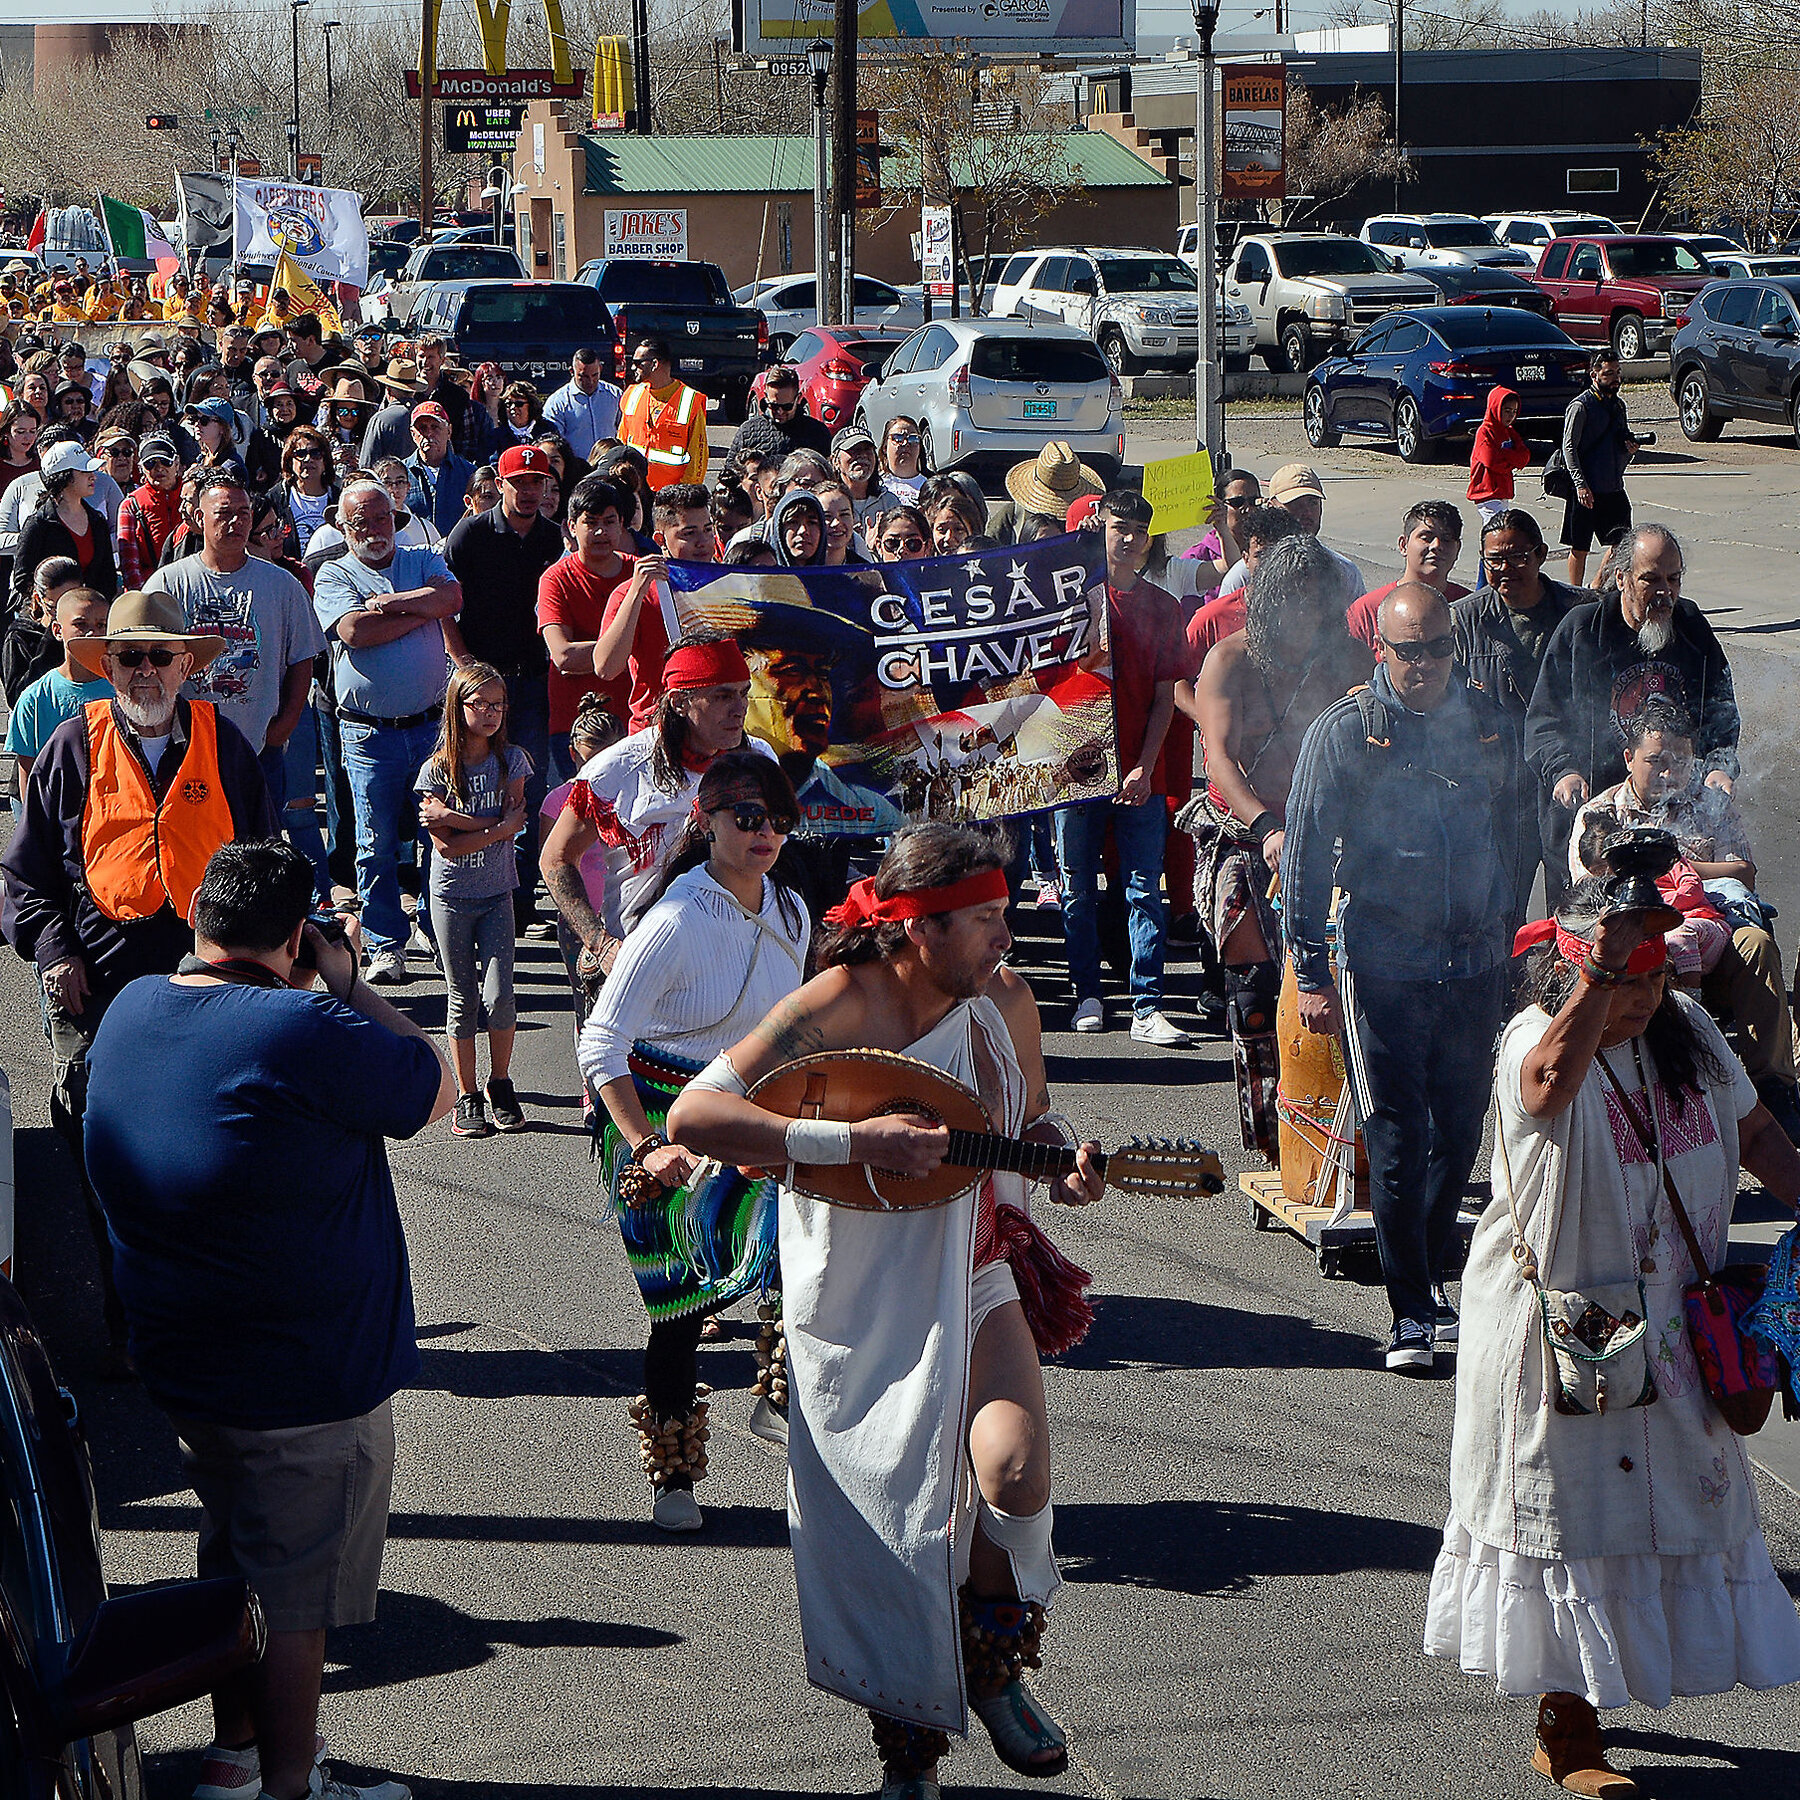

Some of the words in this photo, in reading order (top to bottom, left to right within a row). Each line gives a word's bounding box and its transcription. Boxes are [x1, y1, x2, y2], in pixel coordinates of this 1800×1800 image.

[931, 5, 967, 13] Presented
[967, 5, 977, 14] by
[440, 79, 552, 94] McDonald's
[1229, 87, 1279, 102] BARELAS
[485, 109, 511, 117] UBER
[486, 117, 510, 125] EATS
[469, 131, 522, 139] McDELIVER
[487, 141, 516, 149] AVAILA
[615, 212, 683, 241] JAKE'S
[608, 243, 653, 254] BARBER
[655, 243, 685, 254] SHOP
[469, 361, 604, 372] CEVROL
[521, 449, 534, 465] P
[870, 565, 1088, 630] CESAR
[223, 623, 256, 640] ROSA
[876, 618, 1091, 690] CHAVEZ
